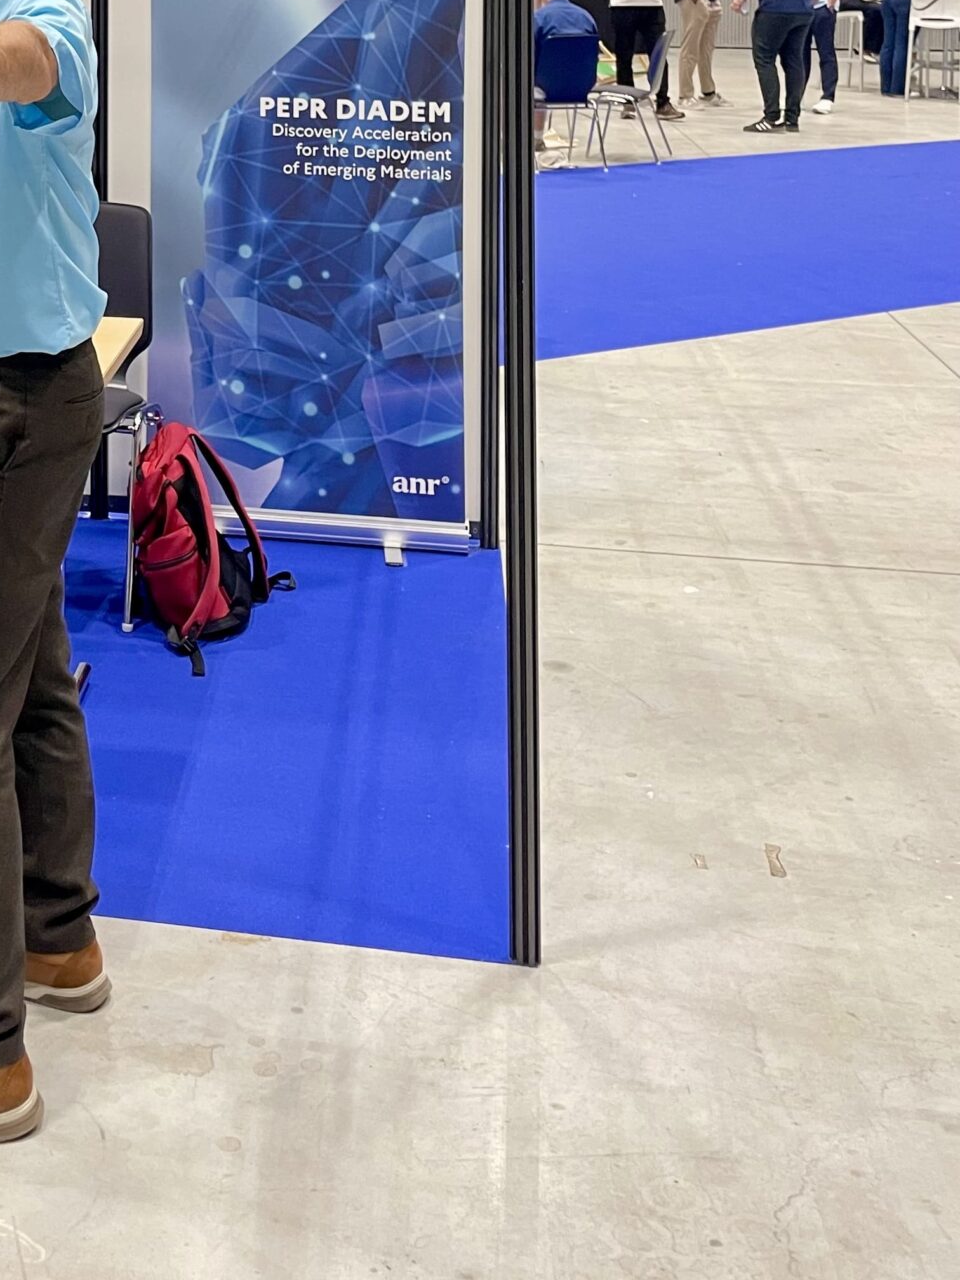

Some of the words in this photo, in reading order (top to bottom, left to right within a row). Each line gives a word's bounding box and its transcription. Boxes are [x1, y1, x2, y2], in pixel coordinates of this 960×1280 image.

[259, 97, 328, 119] PEPR
[336, 99, 451, 123] DIADEM
[272, 124, 347, 142] Discovery
[352, 126, 452, 142] Acceleration
[296, 143, 318, 157] for
[323, 145, 349, 158] the
[354, 146, 452, 163] Deployment
[283, 162, 300, 175] of
[305, 162, 376, 181] Emerging
[381, 165, 452, 181] Materials
